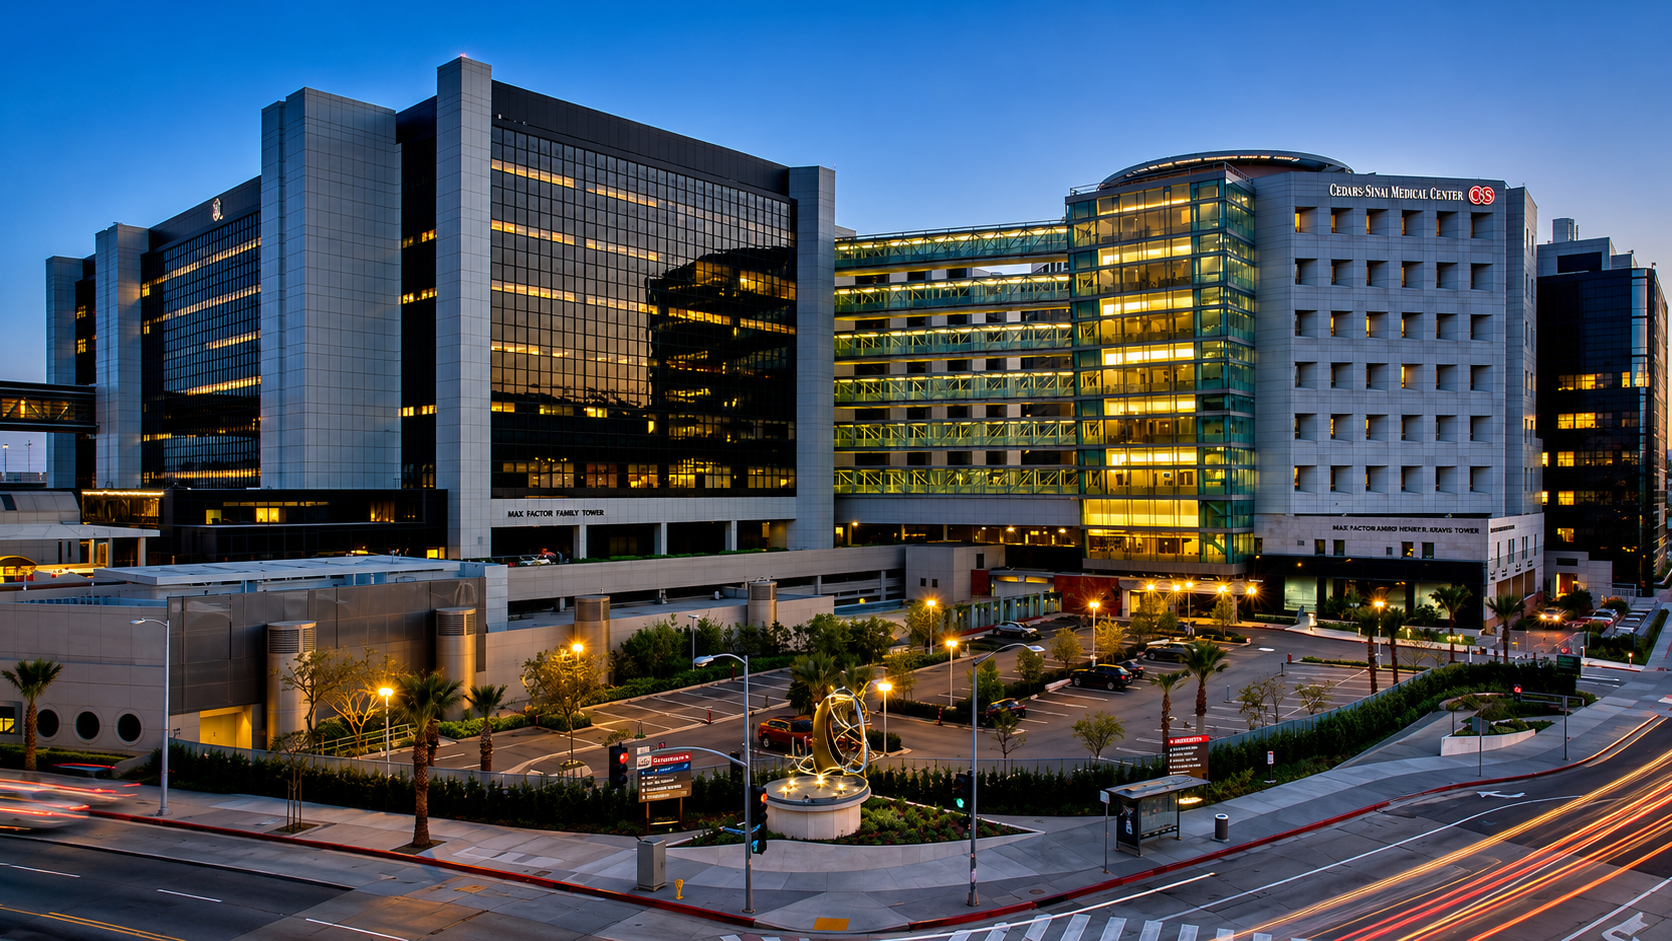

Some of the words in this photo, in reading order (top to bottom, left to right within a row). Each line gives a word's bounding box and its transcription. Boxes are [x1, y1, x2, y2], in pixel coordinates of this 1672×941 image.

[1391, 186, 1429, 200] MEDICAL
[1430, 187, 1464, 201] CENTER
[507, 510, 524, 518] MAX
